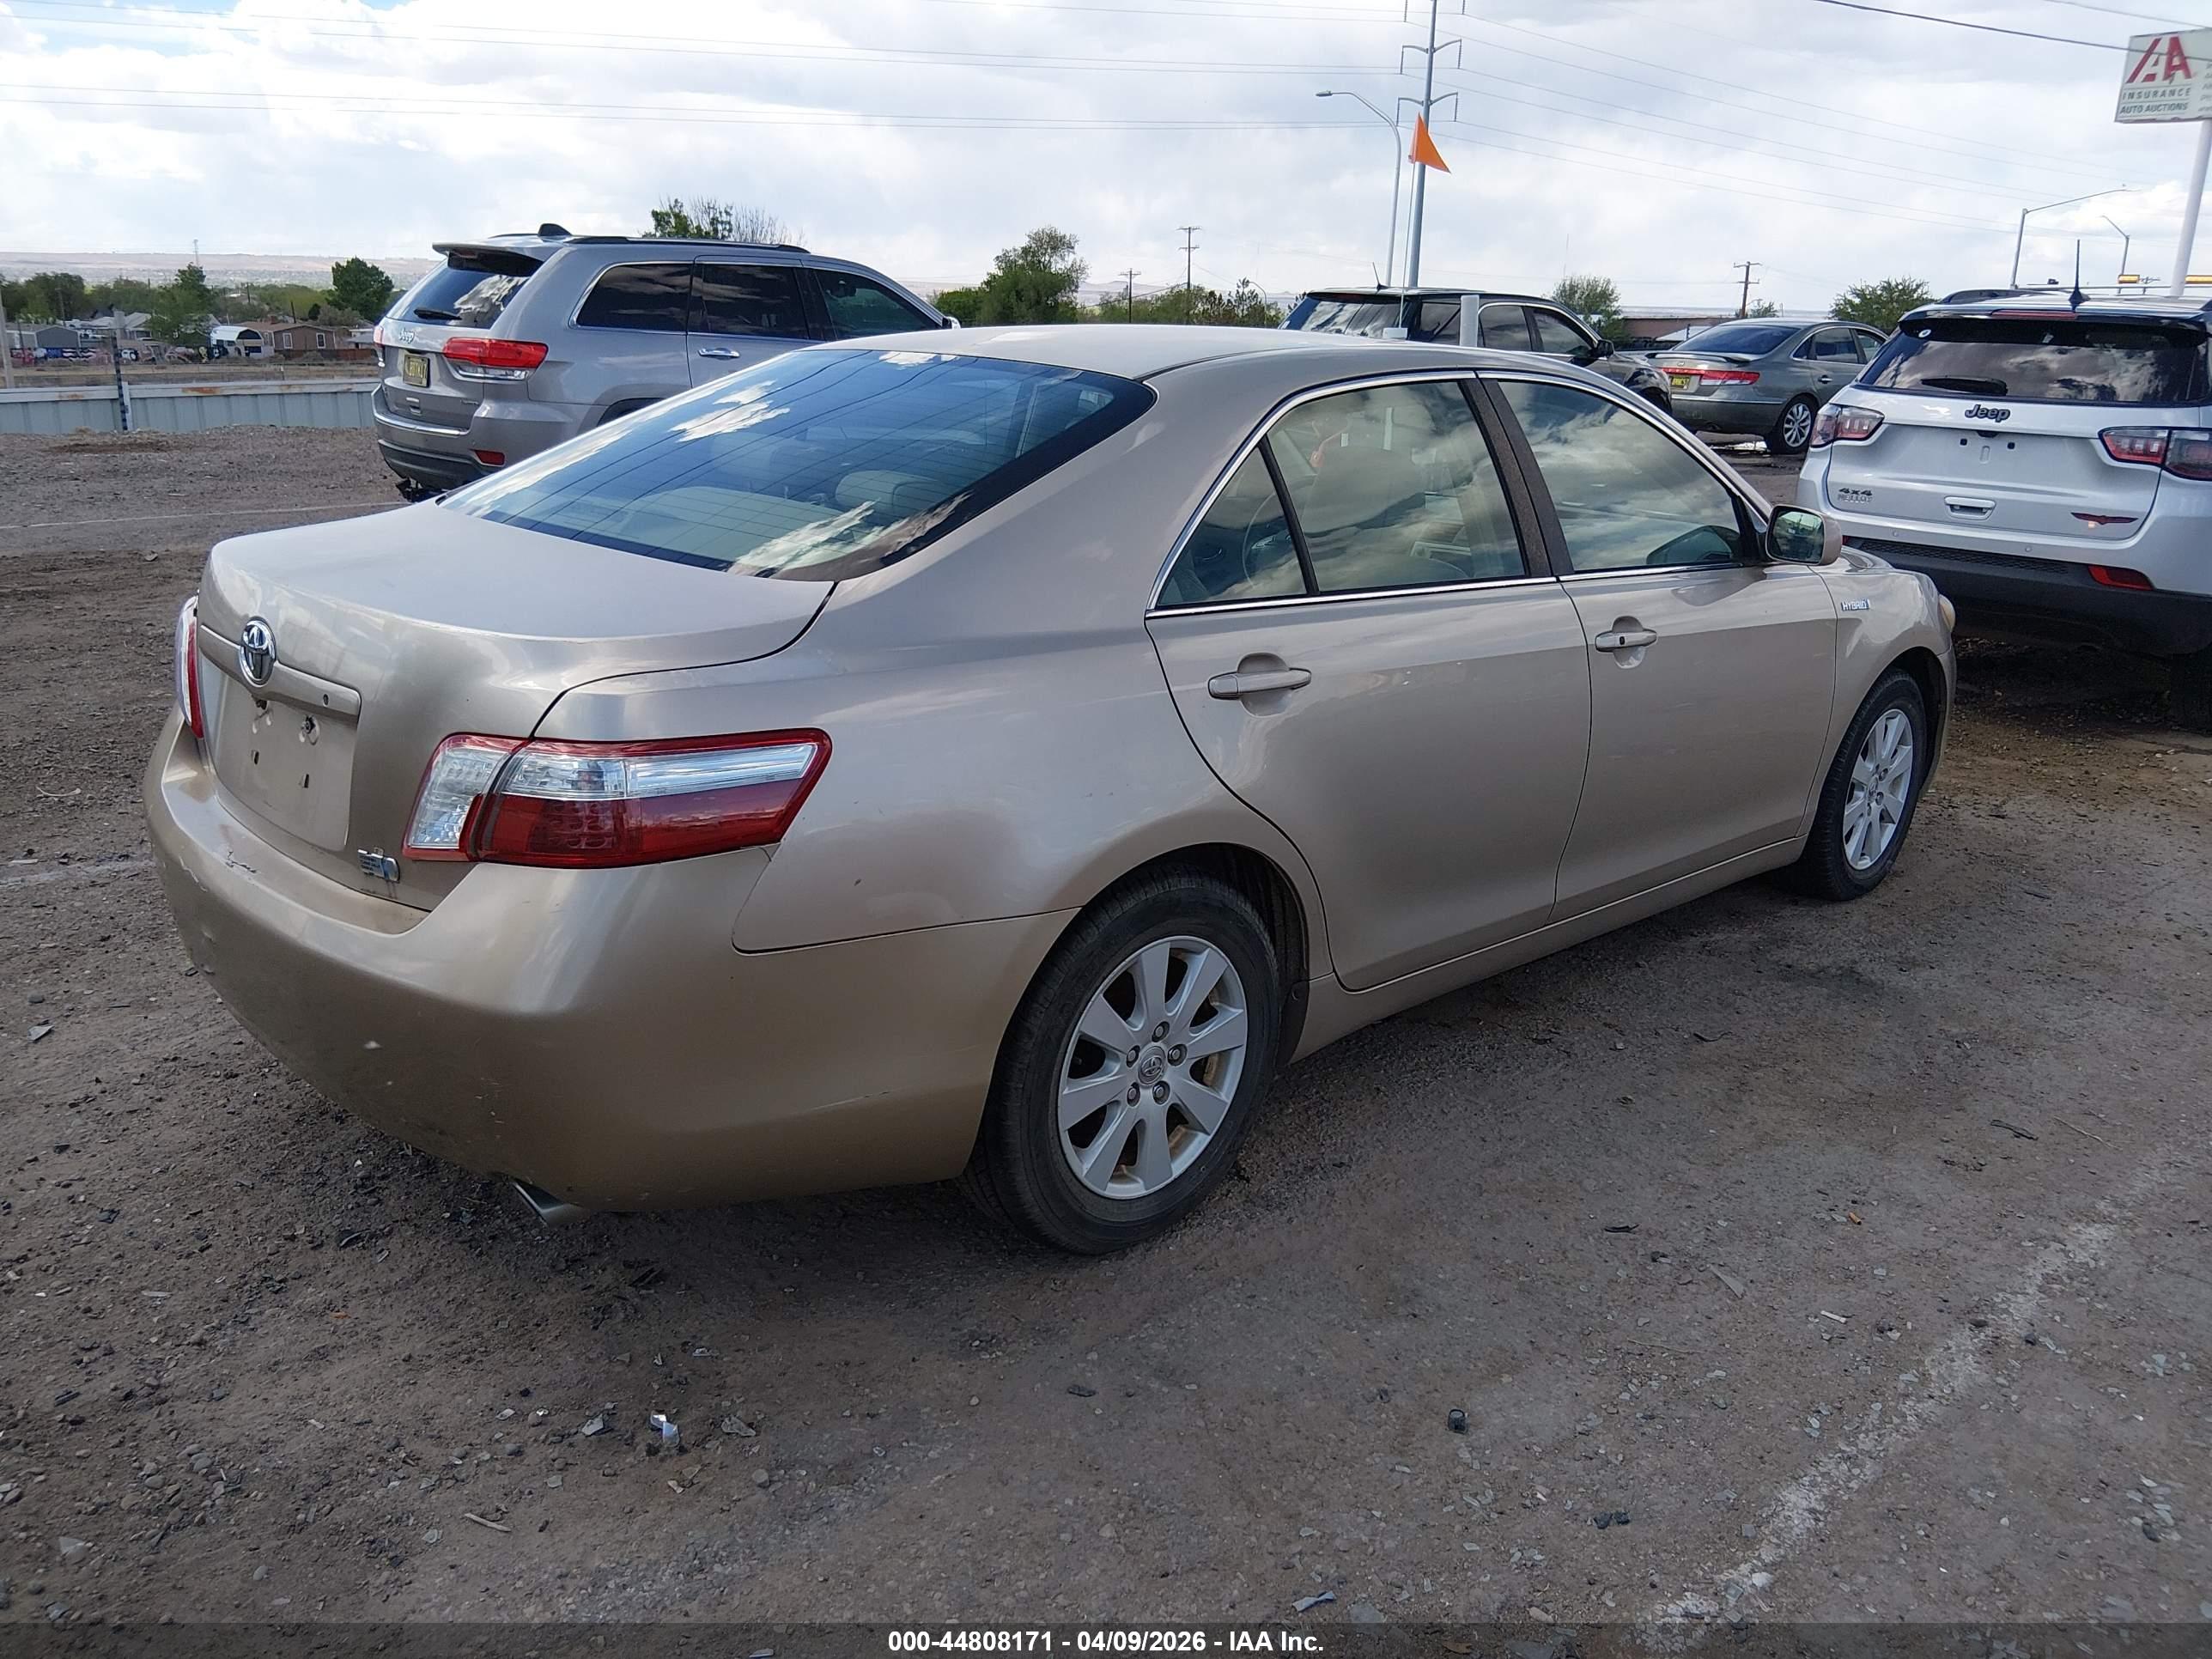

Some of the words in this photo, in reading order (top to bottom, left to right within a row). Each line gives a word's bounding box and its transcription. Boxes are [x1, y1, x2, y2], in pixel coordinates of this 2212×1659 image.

[2122, 87, 2191, 100] INSURANCE
[2119, 105, 2143, 114] AUTO
[2144, 102, 2189, 112] AUCTIONS
[1964, 404, 2011, 423] Jeep
[1838, 488, 1873, 496] 4x4
[1840, 599, 1869, 611] HYBRID
